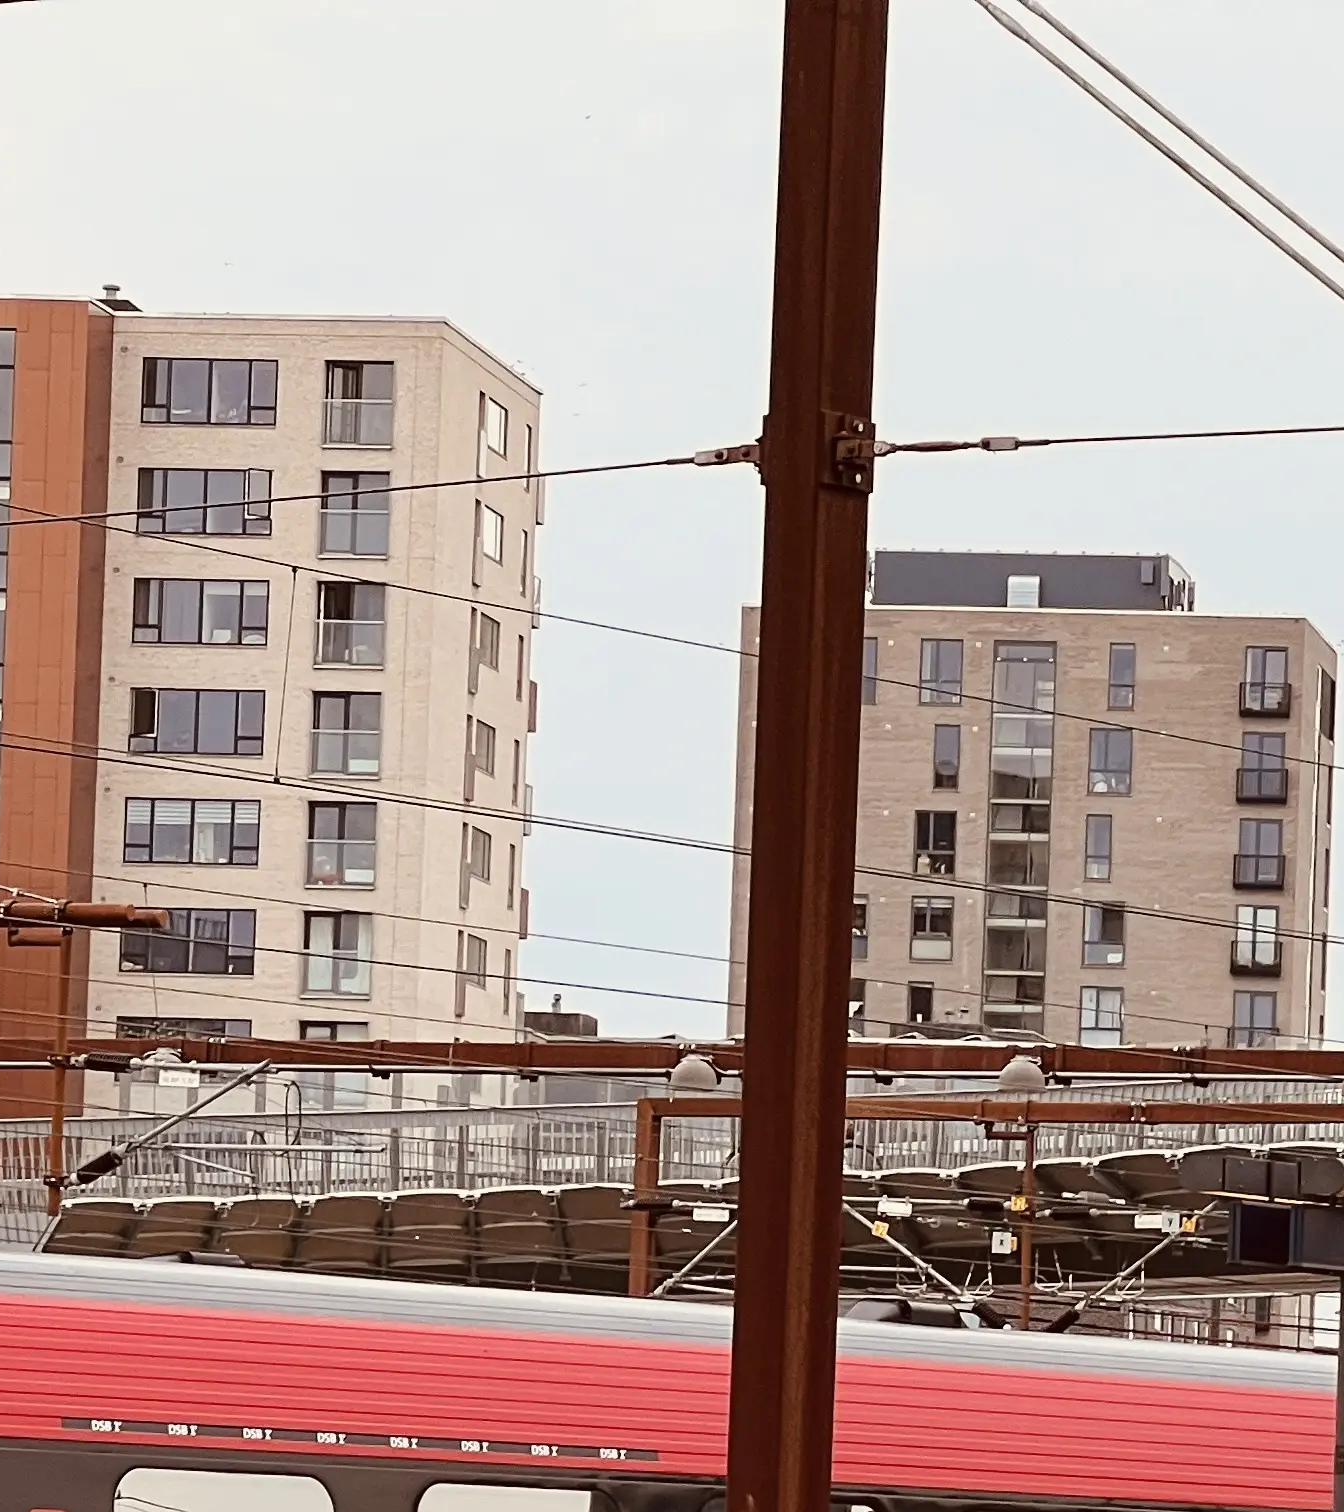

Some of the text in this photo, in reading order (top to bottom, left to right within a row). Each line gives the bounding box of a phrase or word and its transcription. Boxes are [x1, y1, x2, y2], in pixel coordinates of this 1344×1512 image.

[91, 1419, 113, 1432] DSB
[167, 1423, 189, 1436] DSB
[242, 1427, 263, 1440] DSB
[316, 1432, 337, 1444] DSB
[389, 1436, 410, 1449] DSB
[460, 1440, 481, 1452] DSB
[530, 1444, 550, 1456] DSB
[599, 1448, 619, 1460] DSB
